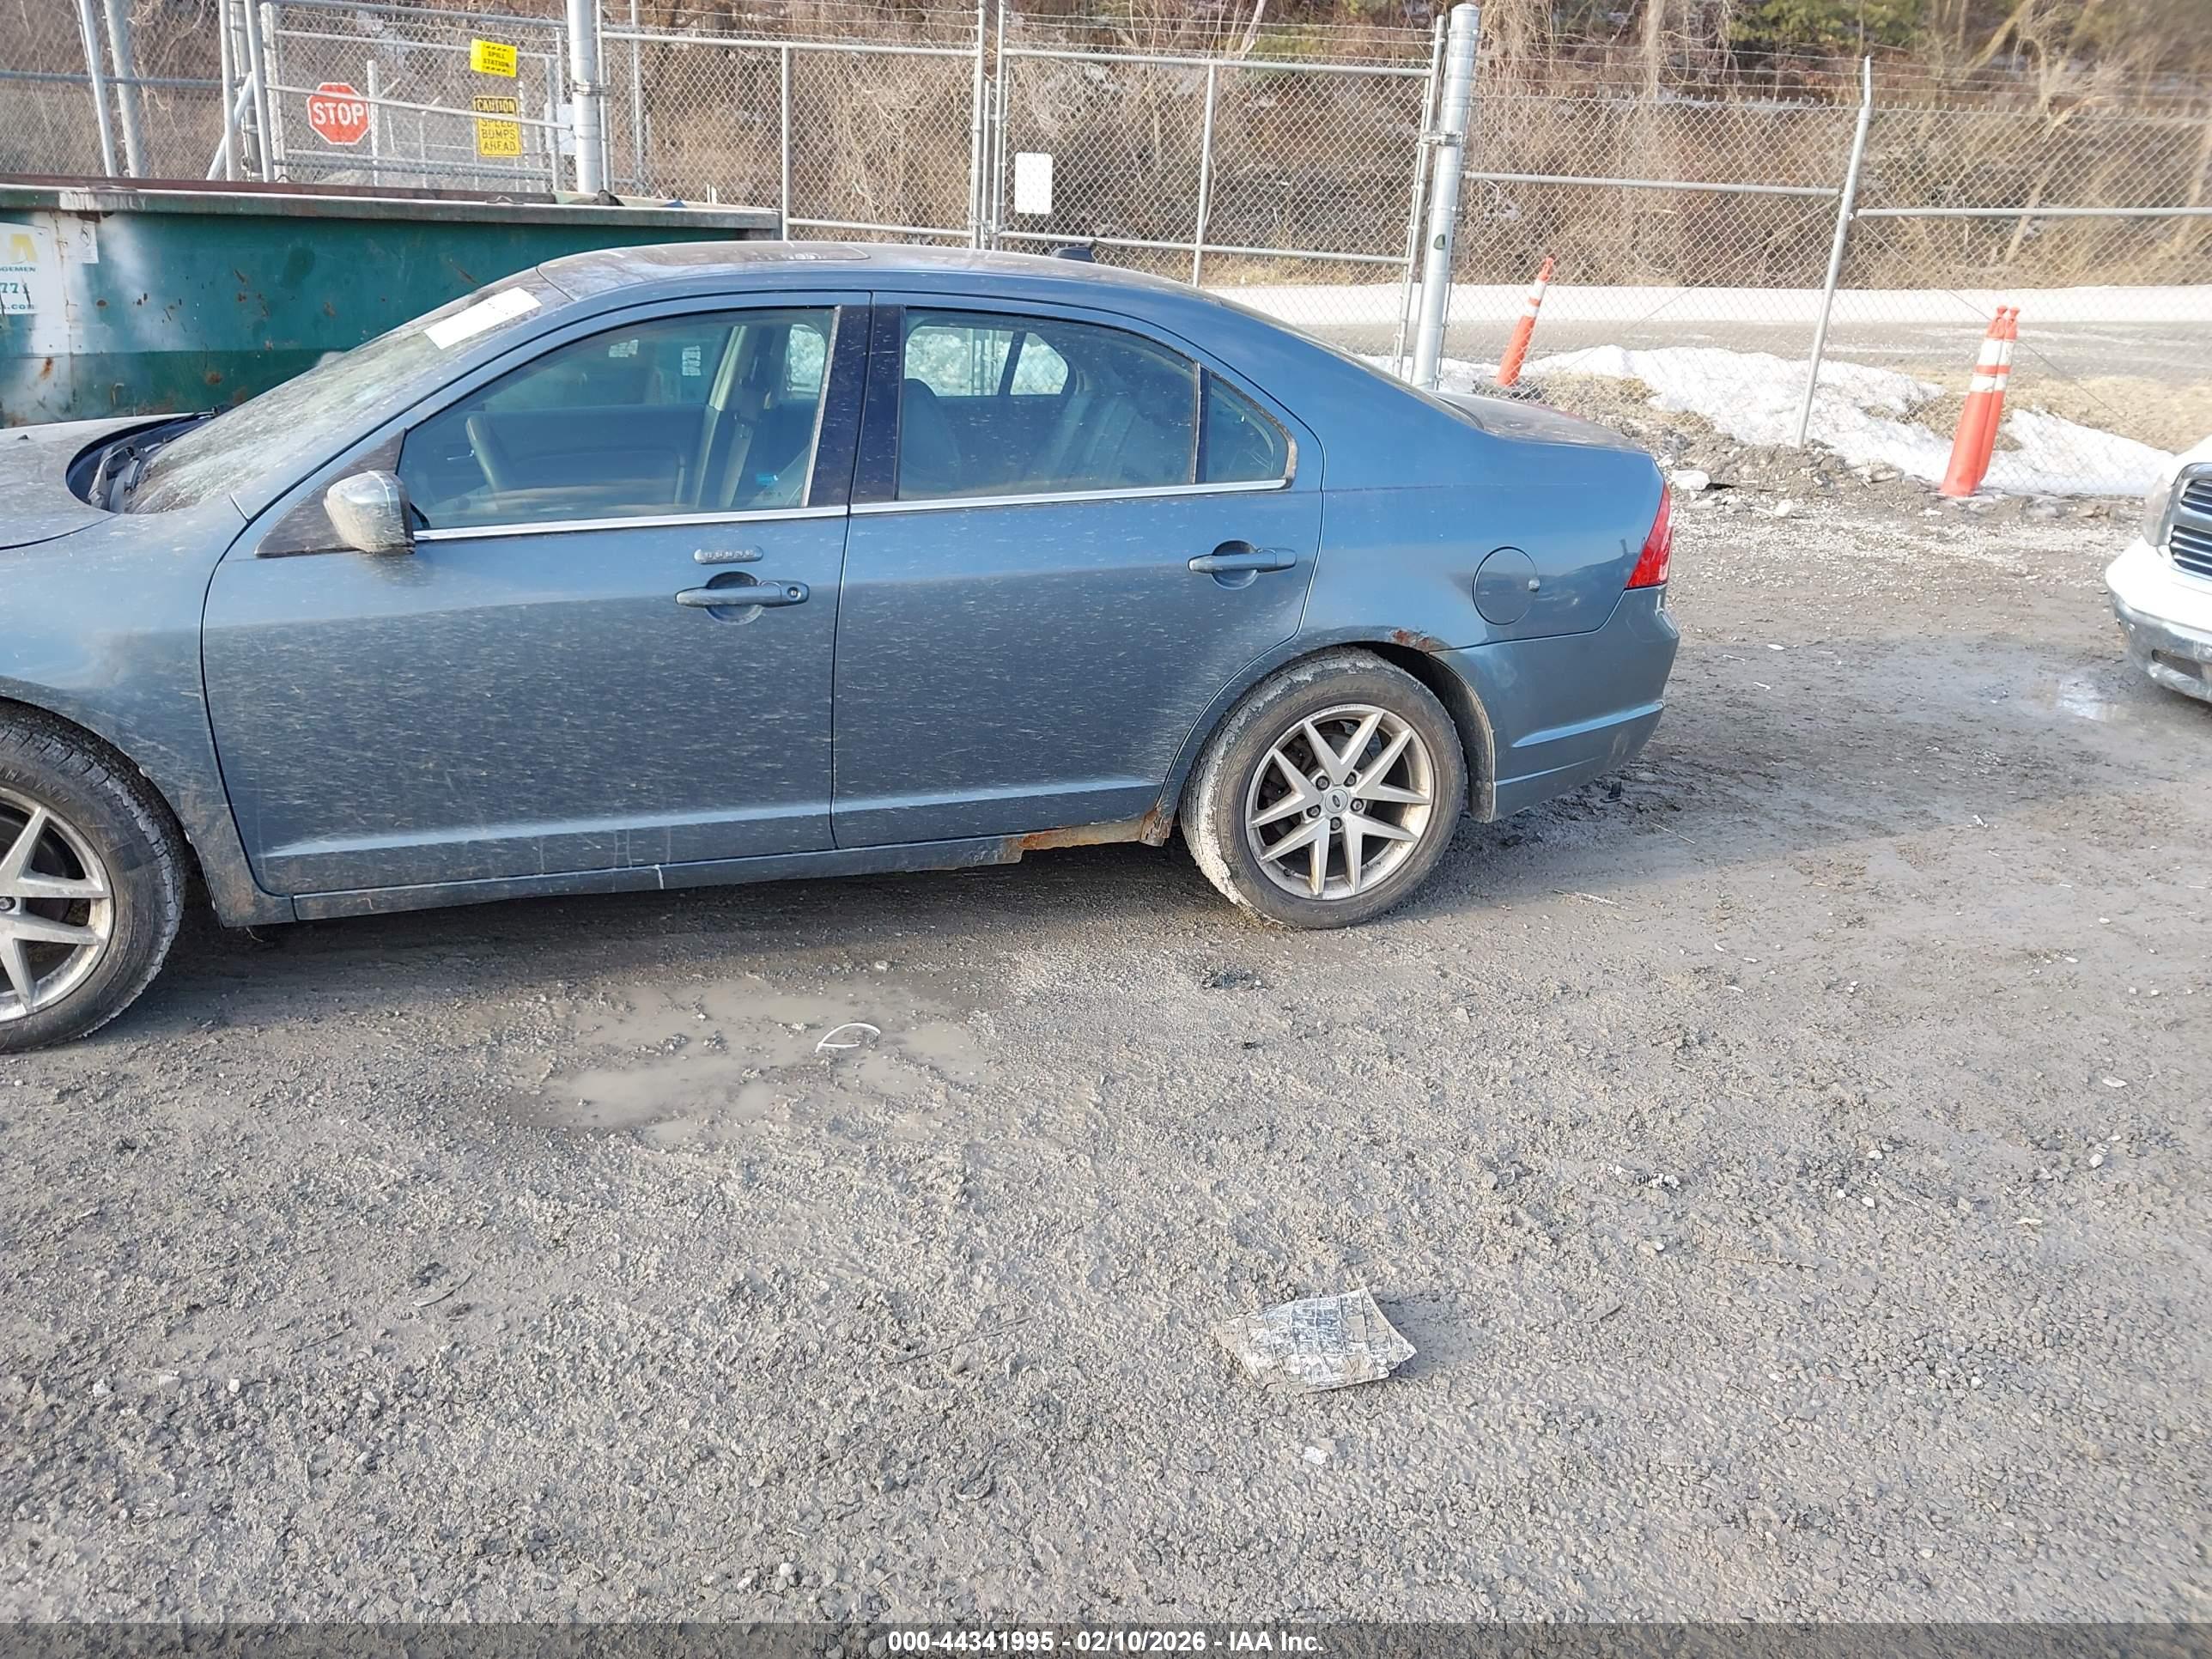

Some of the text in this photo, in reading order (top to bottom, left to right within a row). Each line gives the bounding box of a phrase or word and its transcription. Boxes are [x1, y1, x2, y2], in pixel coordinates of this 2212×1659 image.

[488, 51, 505, 59] SPILL
[483, 58, 510, 68] STATION
[477, 99, 515, 112] CAUTION
[313, 101, 365, 126] STOP
[482, 129, 516, 140] BUMPS
[483, 141, 516, 151] AHEAD
